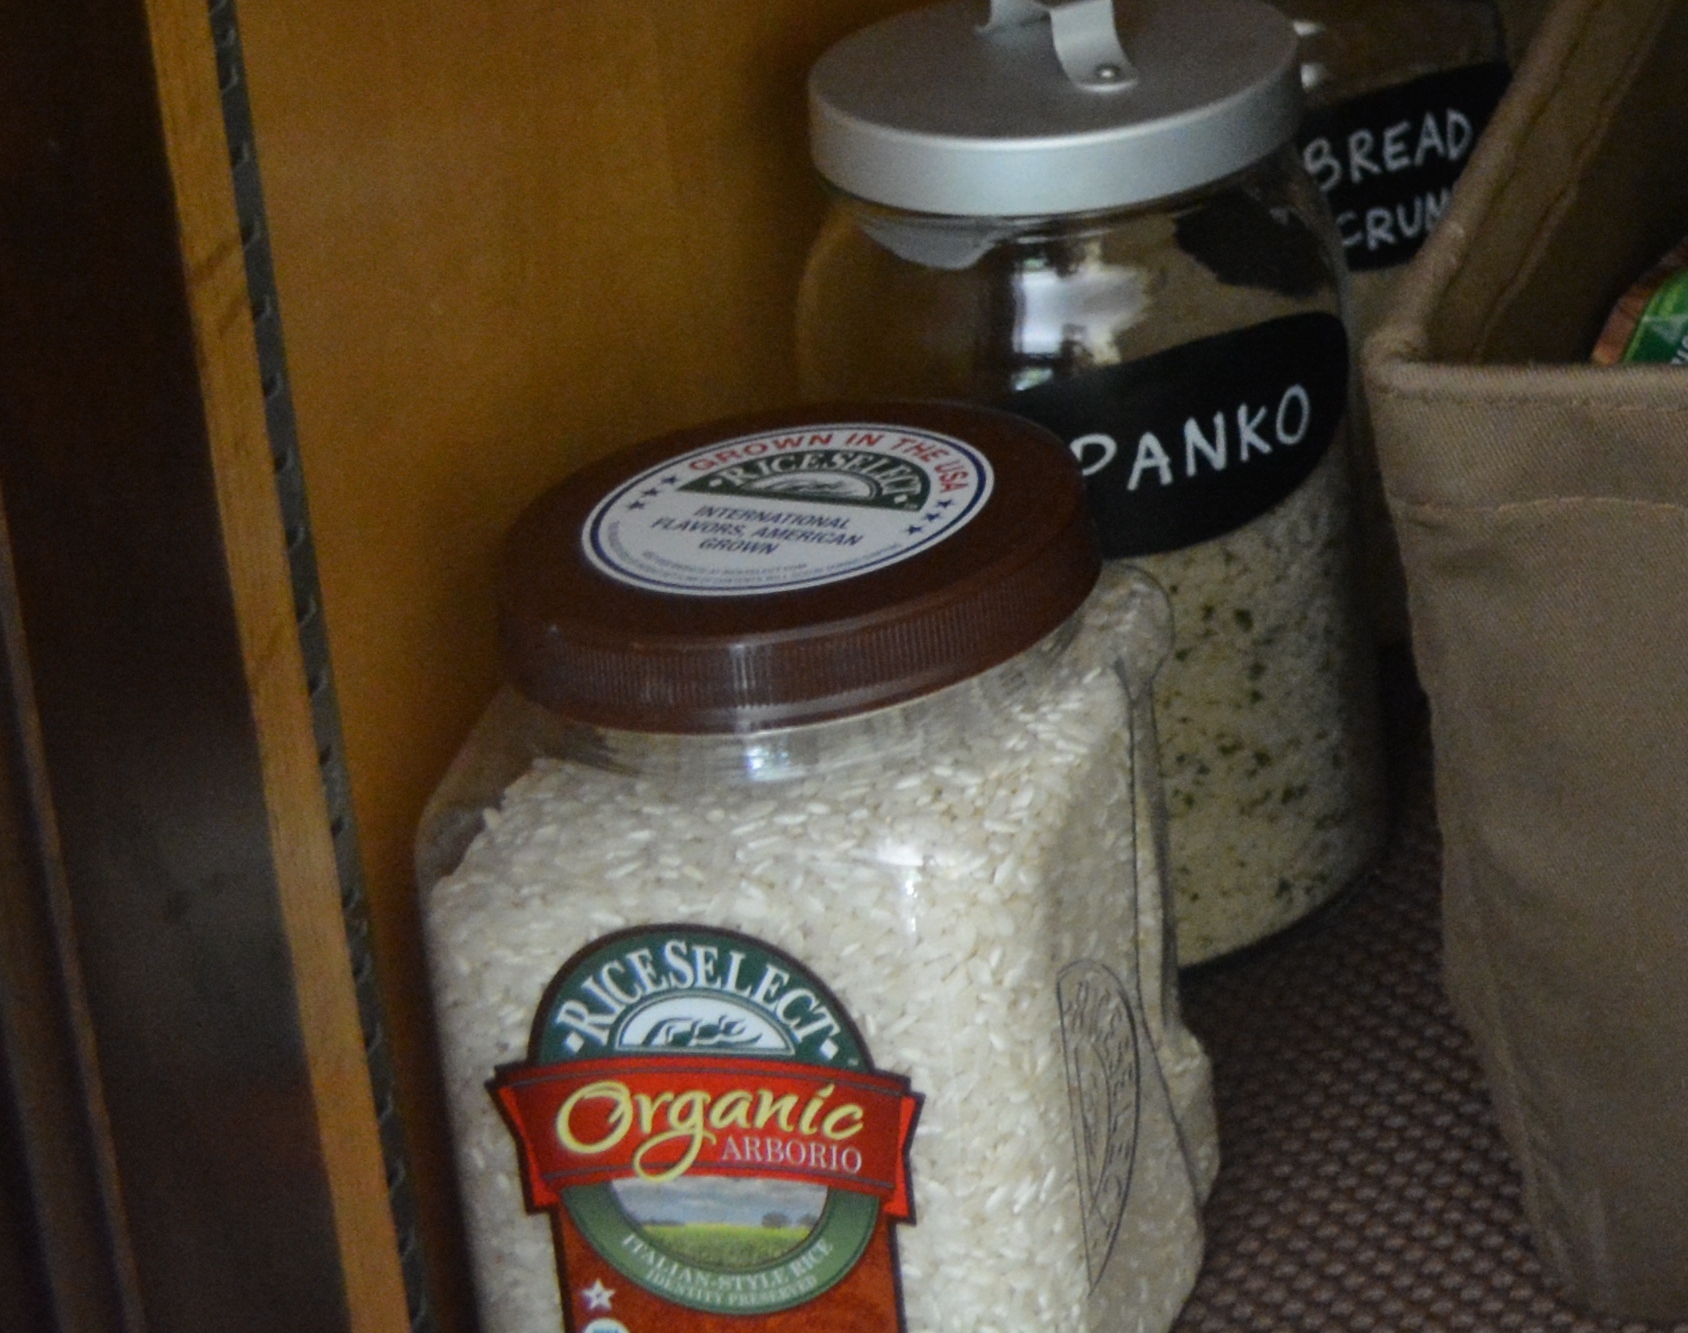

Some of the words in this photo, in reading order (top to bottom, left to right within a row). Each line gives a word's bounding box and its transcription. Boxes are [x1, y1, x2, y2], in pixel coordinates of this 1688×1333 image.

[1303, 108, 1473, 193] BREAD
[1336, 185, 1452, 251] CRUM
[689, 431, 833, 473] GROWN
[846, 431, 884, 449] IN
[889, 436, 939, 464] THE
[933, 452, 970, 495] USA
[1069, 384, 1311, 492] PANKO
[719, 448, 925, 505] RICESELECT
[651, 517, 747, 538] FLAVORS,
[754, 525, 864, 548] AMERICAN
[694, 504, 853, 531] INTERNATIONAL
[698, 536, 780, 556] GROWN
[555, 939, 842, 1047] RICESELECT
[555, 1080, 866, 1183] Organic
[721, 1135, 863, 1176] ARBORIO
[621, 1233, 790, 1293] ITALIAN-STYLE
